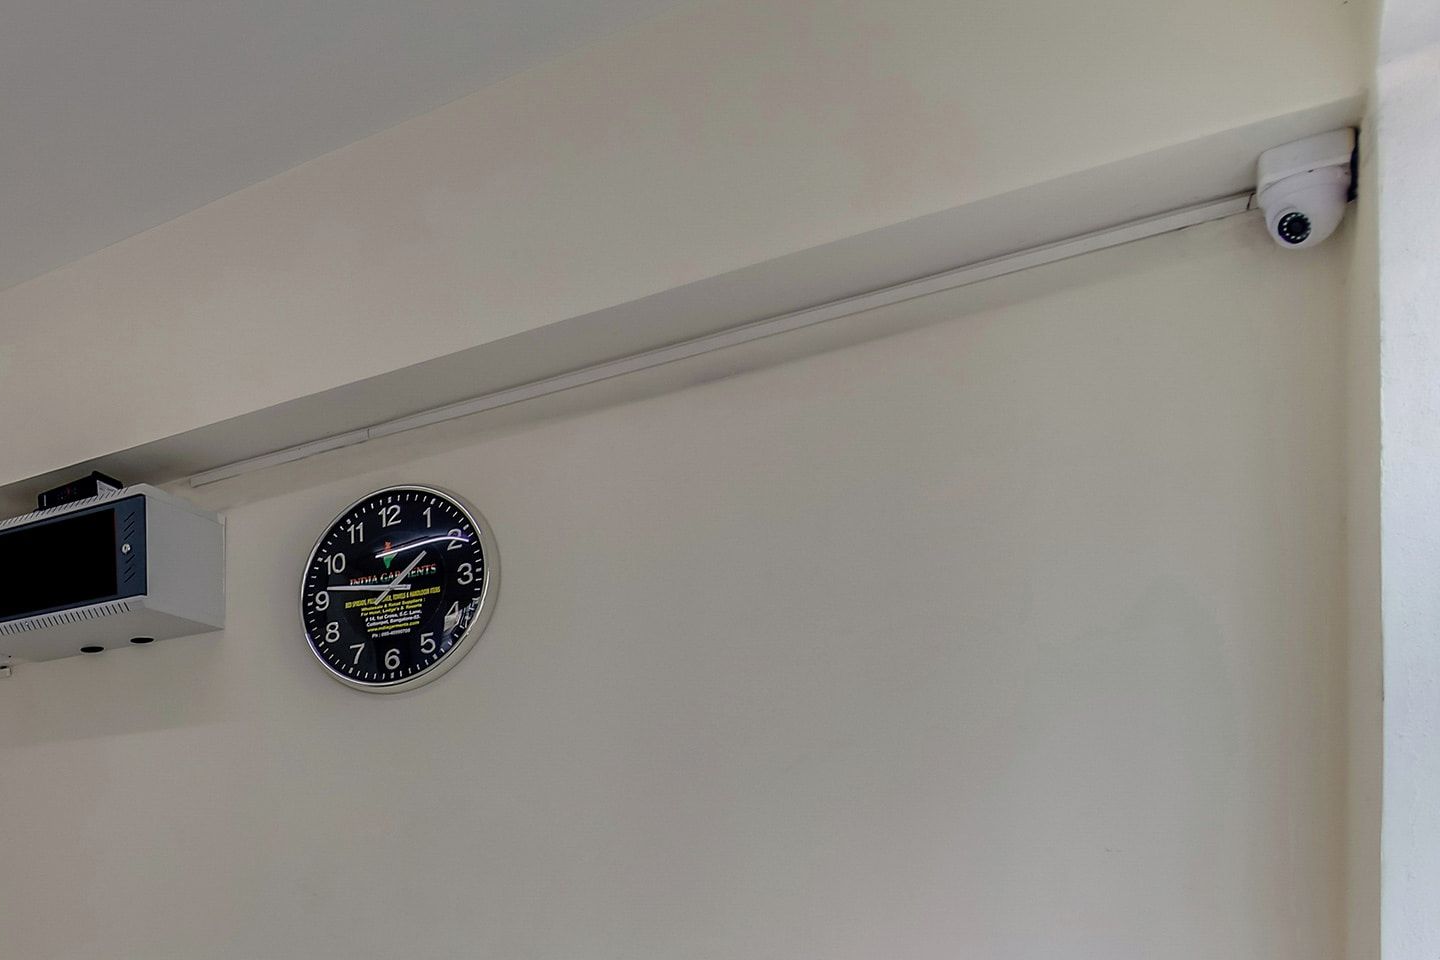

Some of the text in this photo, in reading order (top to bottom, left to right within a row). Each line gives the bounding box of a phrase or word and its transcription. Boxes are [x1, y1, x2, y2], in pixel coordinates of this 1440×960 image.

[378, 505, 401, 528] 12
[423, 507, 432, 528] 1
[348, 522, 364, 544] 11
[447, 528, 463, 550] 2
[324, 553, 345, 575] 10
[350, 564, 436, 585] INDIA GARENTS
[457, 563, 473, 584] 3
[316, 591, 329, 611] 9
[326, 622, 340, 642] 8
[350, 643, 364, 664] 7
[421, 633, 436, 653] 5
[385, 649, 400, 669] 6
